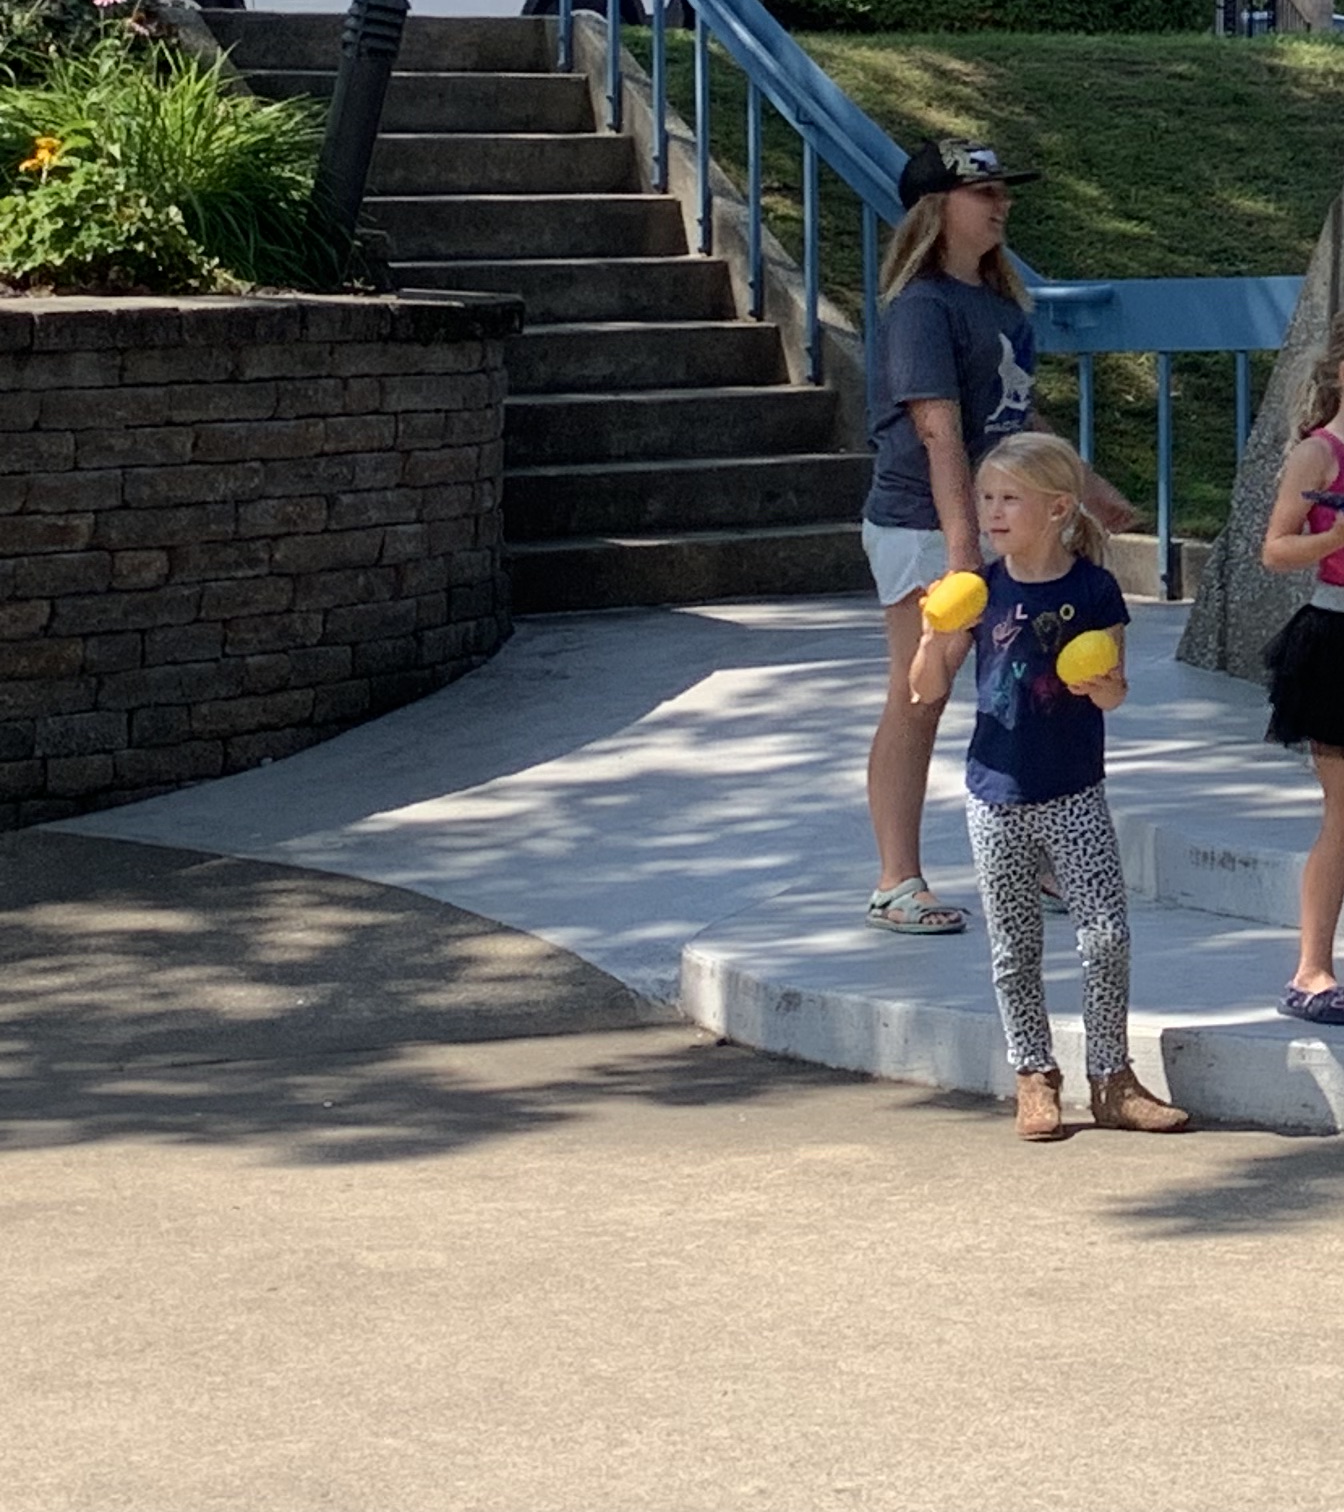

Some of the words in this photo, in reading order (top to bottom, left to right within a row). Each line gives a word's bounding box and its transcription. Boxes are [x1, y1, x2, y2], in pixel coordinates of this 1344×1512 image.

[1016, 603, 1028, 620] L
[1060, 604, 1075, 621] O
[1012, 661, 1026, 679] V
